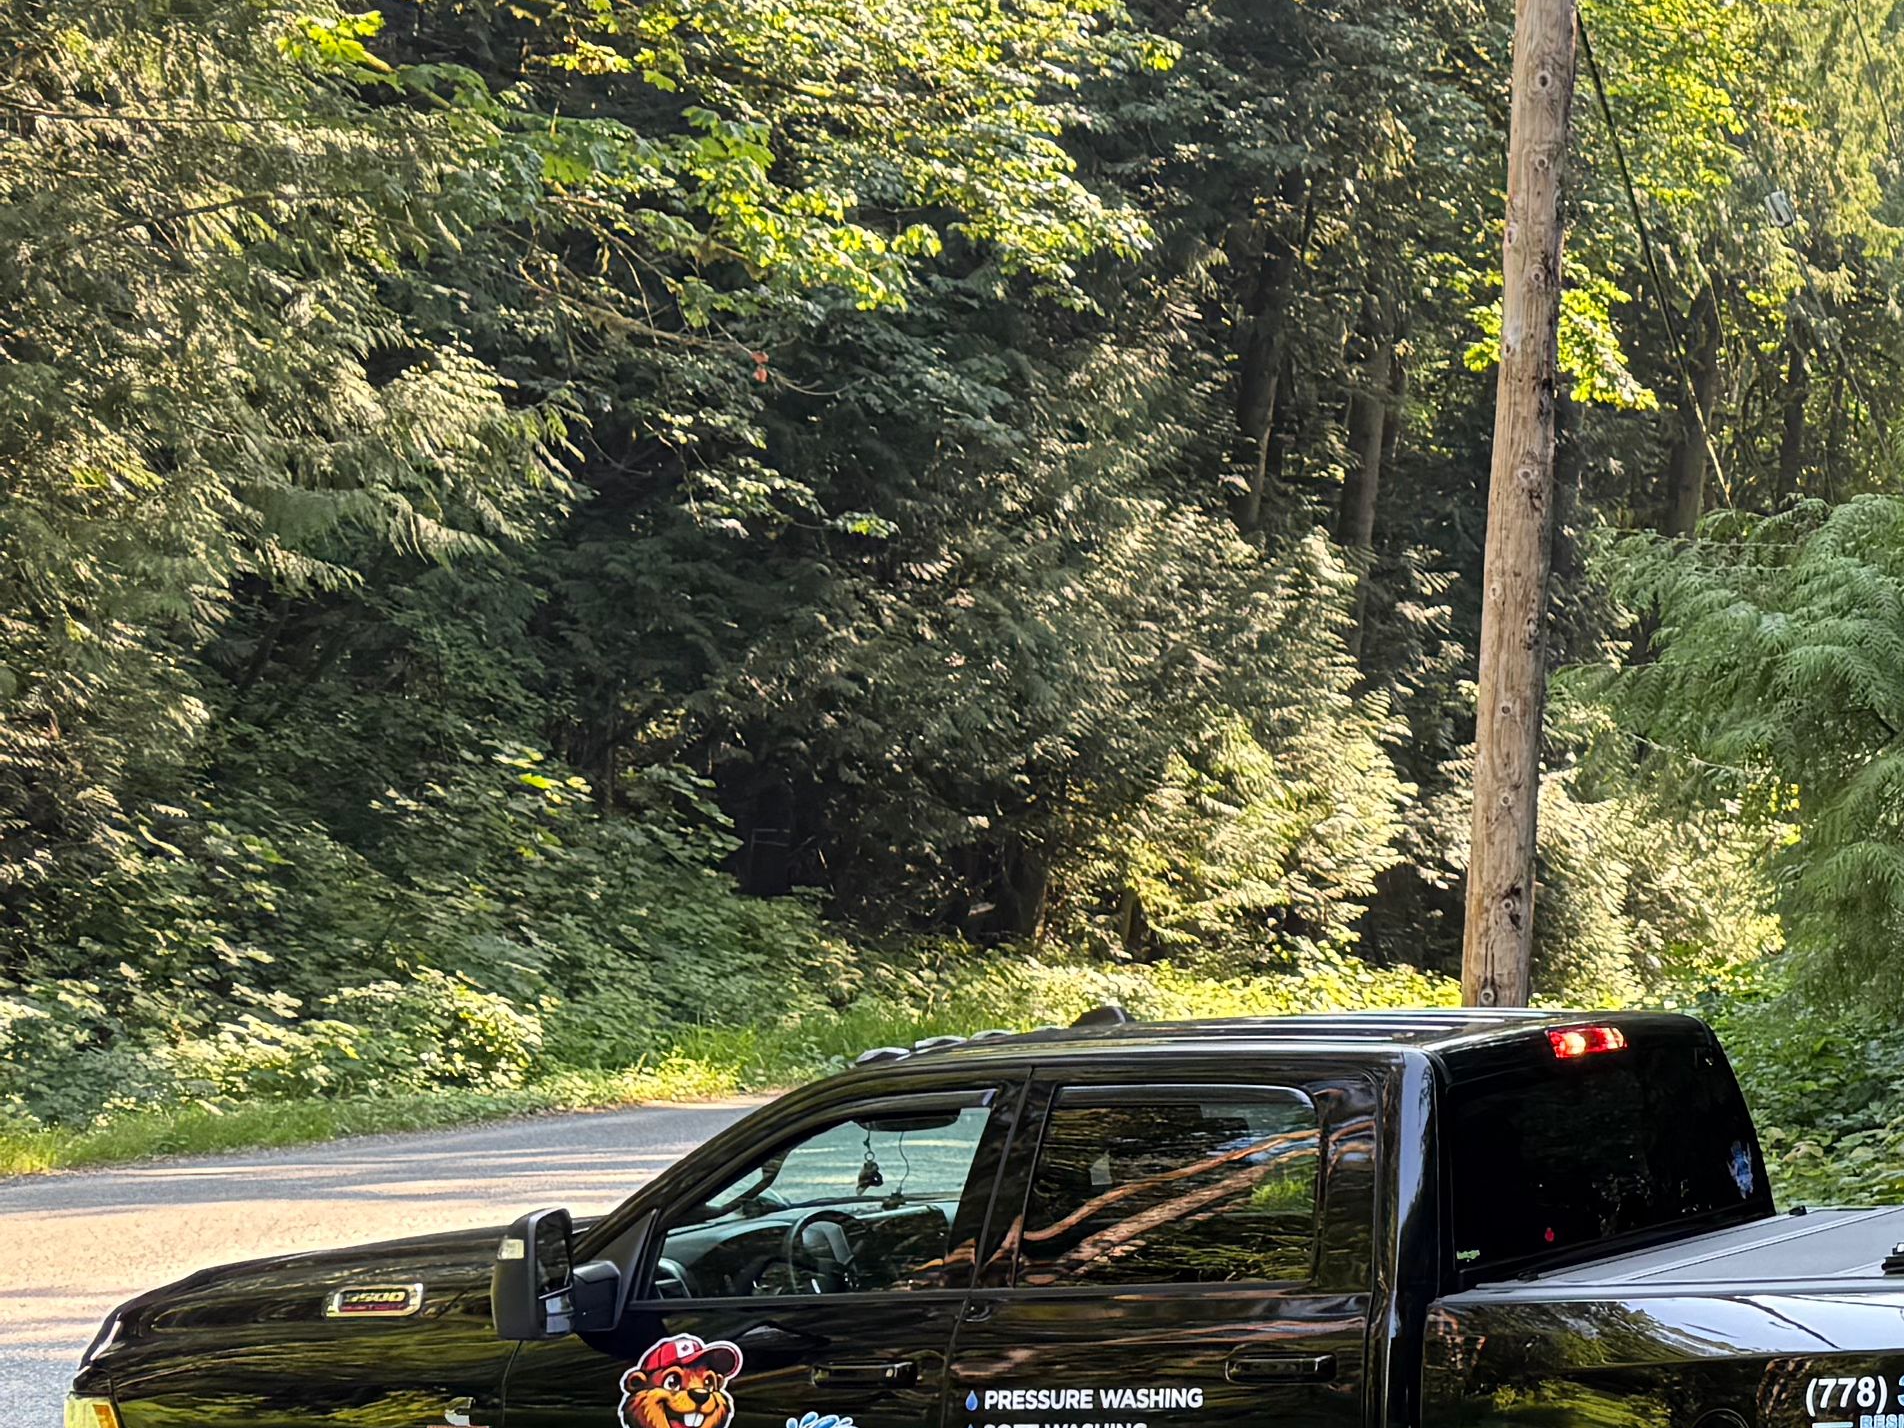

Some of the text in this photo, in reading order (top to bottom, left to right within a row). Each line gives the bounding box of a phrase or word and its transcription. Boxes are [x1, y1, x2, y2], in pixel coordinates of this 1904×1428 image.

[984, 1388, 1203, 1410] PRESSURE WASHING
[1805, 1375, 1888, 1417] (778)
